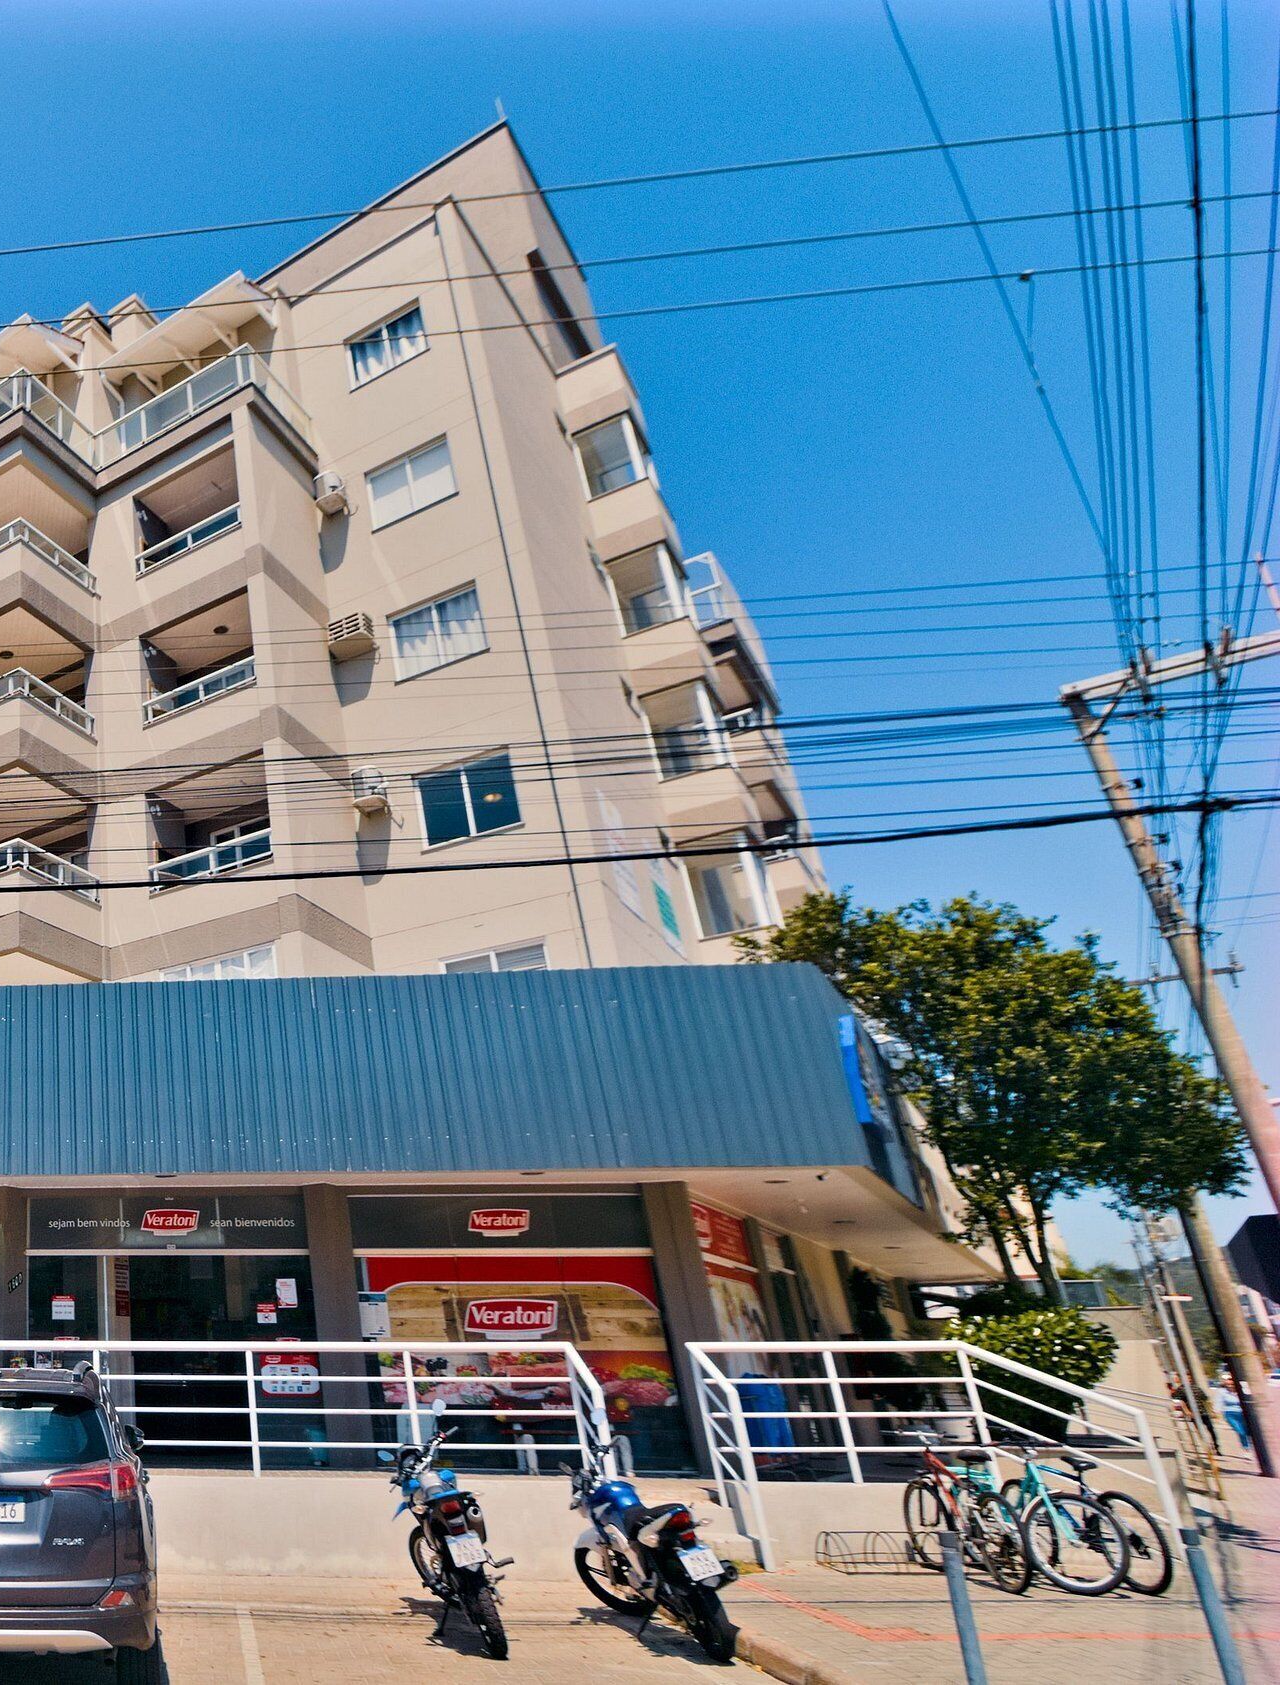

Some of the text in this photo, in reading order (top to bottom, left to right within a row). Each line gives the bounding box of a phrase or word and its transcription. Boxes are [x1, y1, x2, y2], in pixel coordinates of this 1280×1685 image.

[48, 1218, 131, 1230] sejam bem vindos
[147, 1213, 197, 1227] Veratoni
[209, 1217, 295, 1228] sean bienvenidos
[472, 1213, 527, 1227] Veratoni
[471, 1306, 554, 1325] Veratoni
